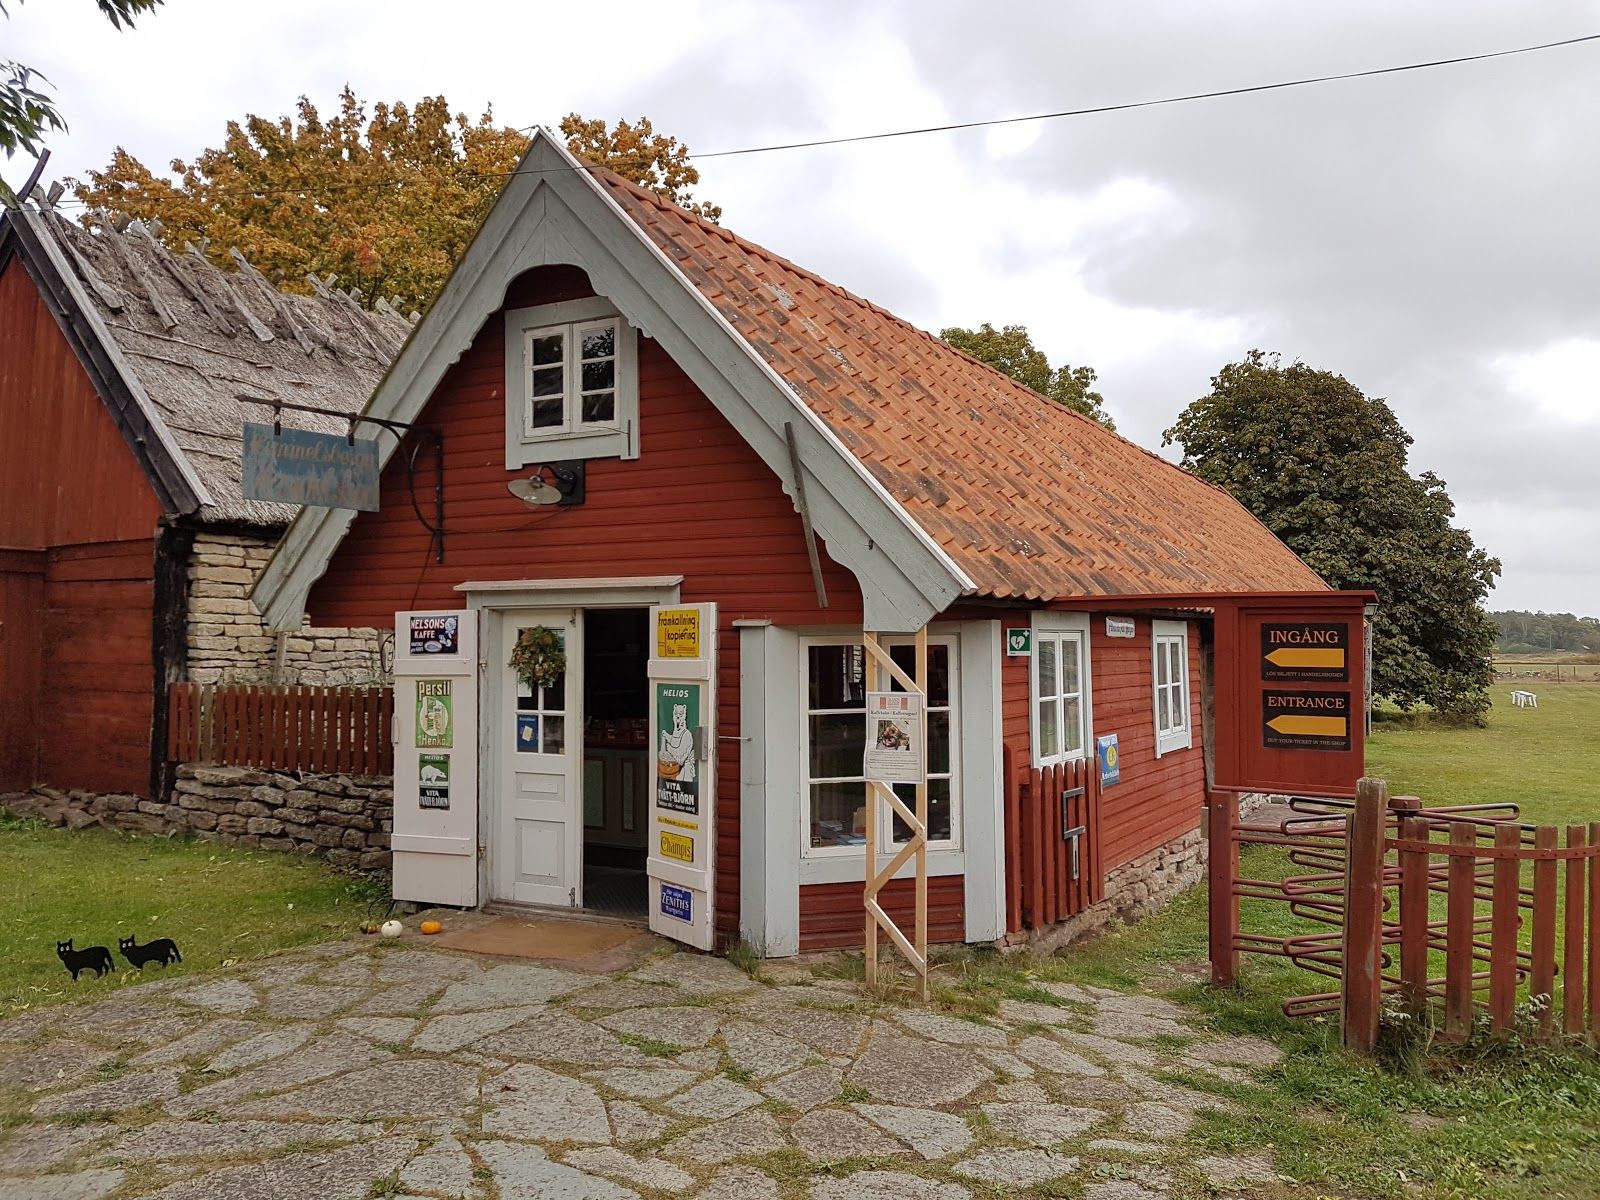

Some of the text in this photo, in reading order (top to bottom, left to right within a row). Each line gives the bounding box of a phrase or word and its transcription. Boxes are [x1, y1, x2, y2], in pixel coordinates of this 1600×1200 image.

[411, 619, 446, 630] NELSONS
[414, 630, 436, 639] KAFFE
[1270, 627, 1339, 644] INGÅNG
[418, 681, 450, 701] Persil
[663, 689, 689, 698] HELIOS
[1268, 696, 1345, 709] ENTRANCE
[665, 781, 681, 791] VITA
[425, 789, 440, 797] VITA
[661, 836, 691, 858] Champis
